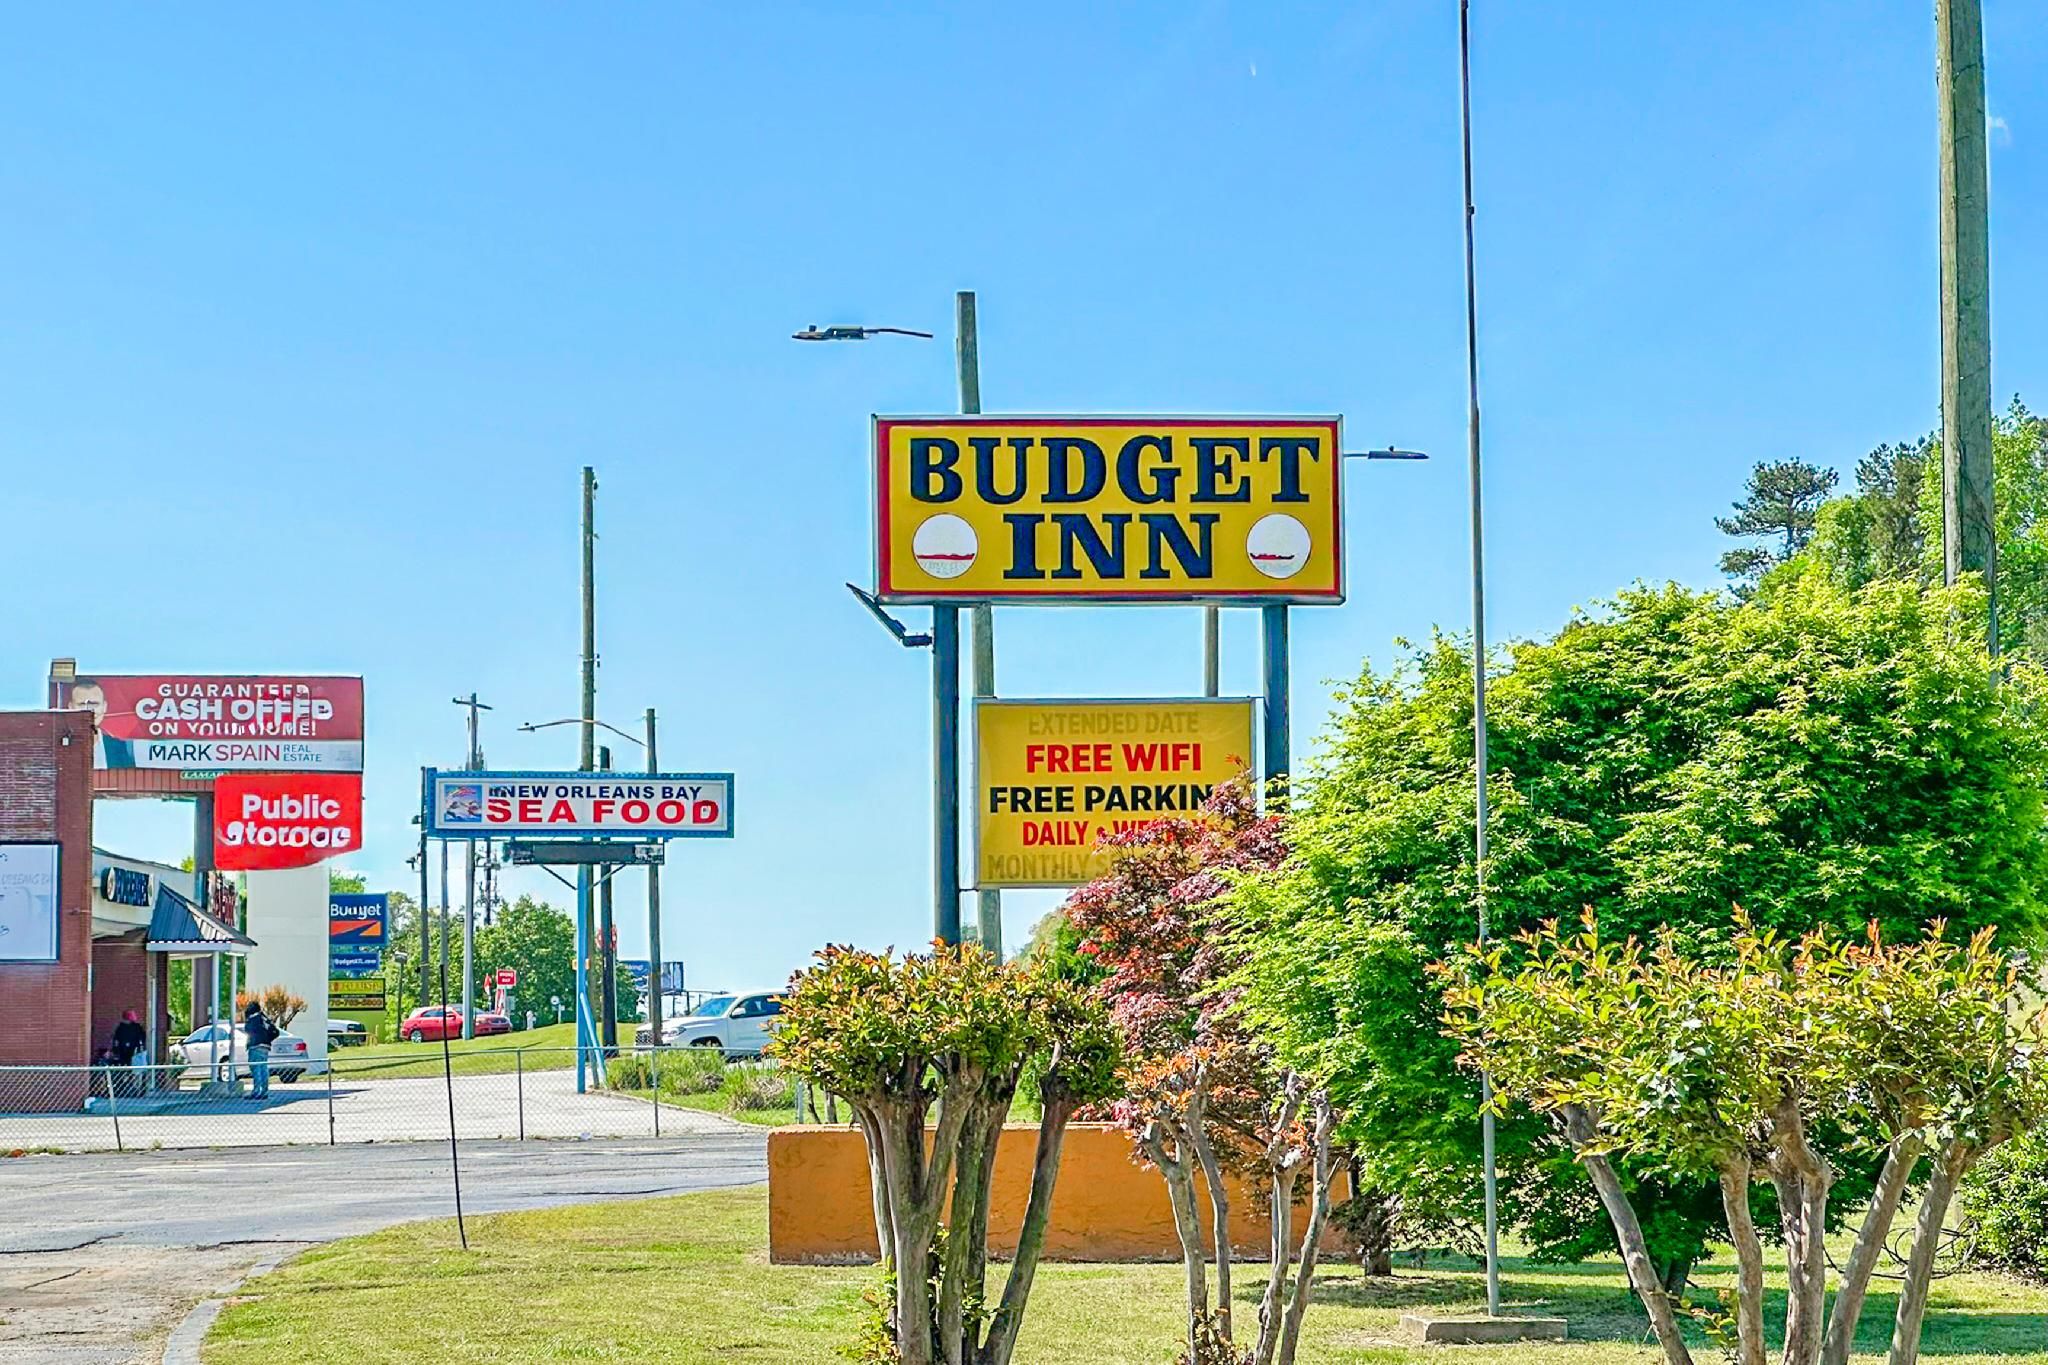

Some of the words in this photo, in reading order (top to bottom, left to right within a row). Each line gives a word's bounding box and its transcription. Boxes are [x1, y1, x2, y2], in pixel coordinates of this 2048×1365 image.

[910, 435, 1320, 504] BUDGET
[1003, 513, 1220, 579] INN
[135, 698, 222, 720] CASH
[149, 722, 178, 736] ON
[1028, 711, 1140, 735] EXTENDED
[1145, 711, 1199, 734] DATE
[149, 744, 212, 761] MARK
[215, 744, 280, 761] SPAIN
[283, 744, 311, 753] REAL
[283, 753, 322, 762] ESTATE
[1026, 744, 1113, 773] FREE
[1121, 743, 1202, 772] WIFI
[555, 785, 655, 798] ORLEANS
[661, 786, 702, 800] BAY
[990, 786, 1075, 813] FREE
[1084, 784, 1213, 812] PARKIN
[242, 793, 340, 819] Public
[486, 799, 577, 823] SEA
[592, 799, 719, 824] FOOD
[1023, 821, 1088, 846] DAILY
[987, 854, 1090, 879] MONTHLY
